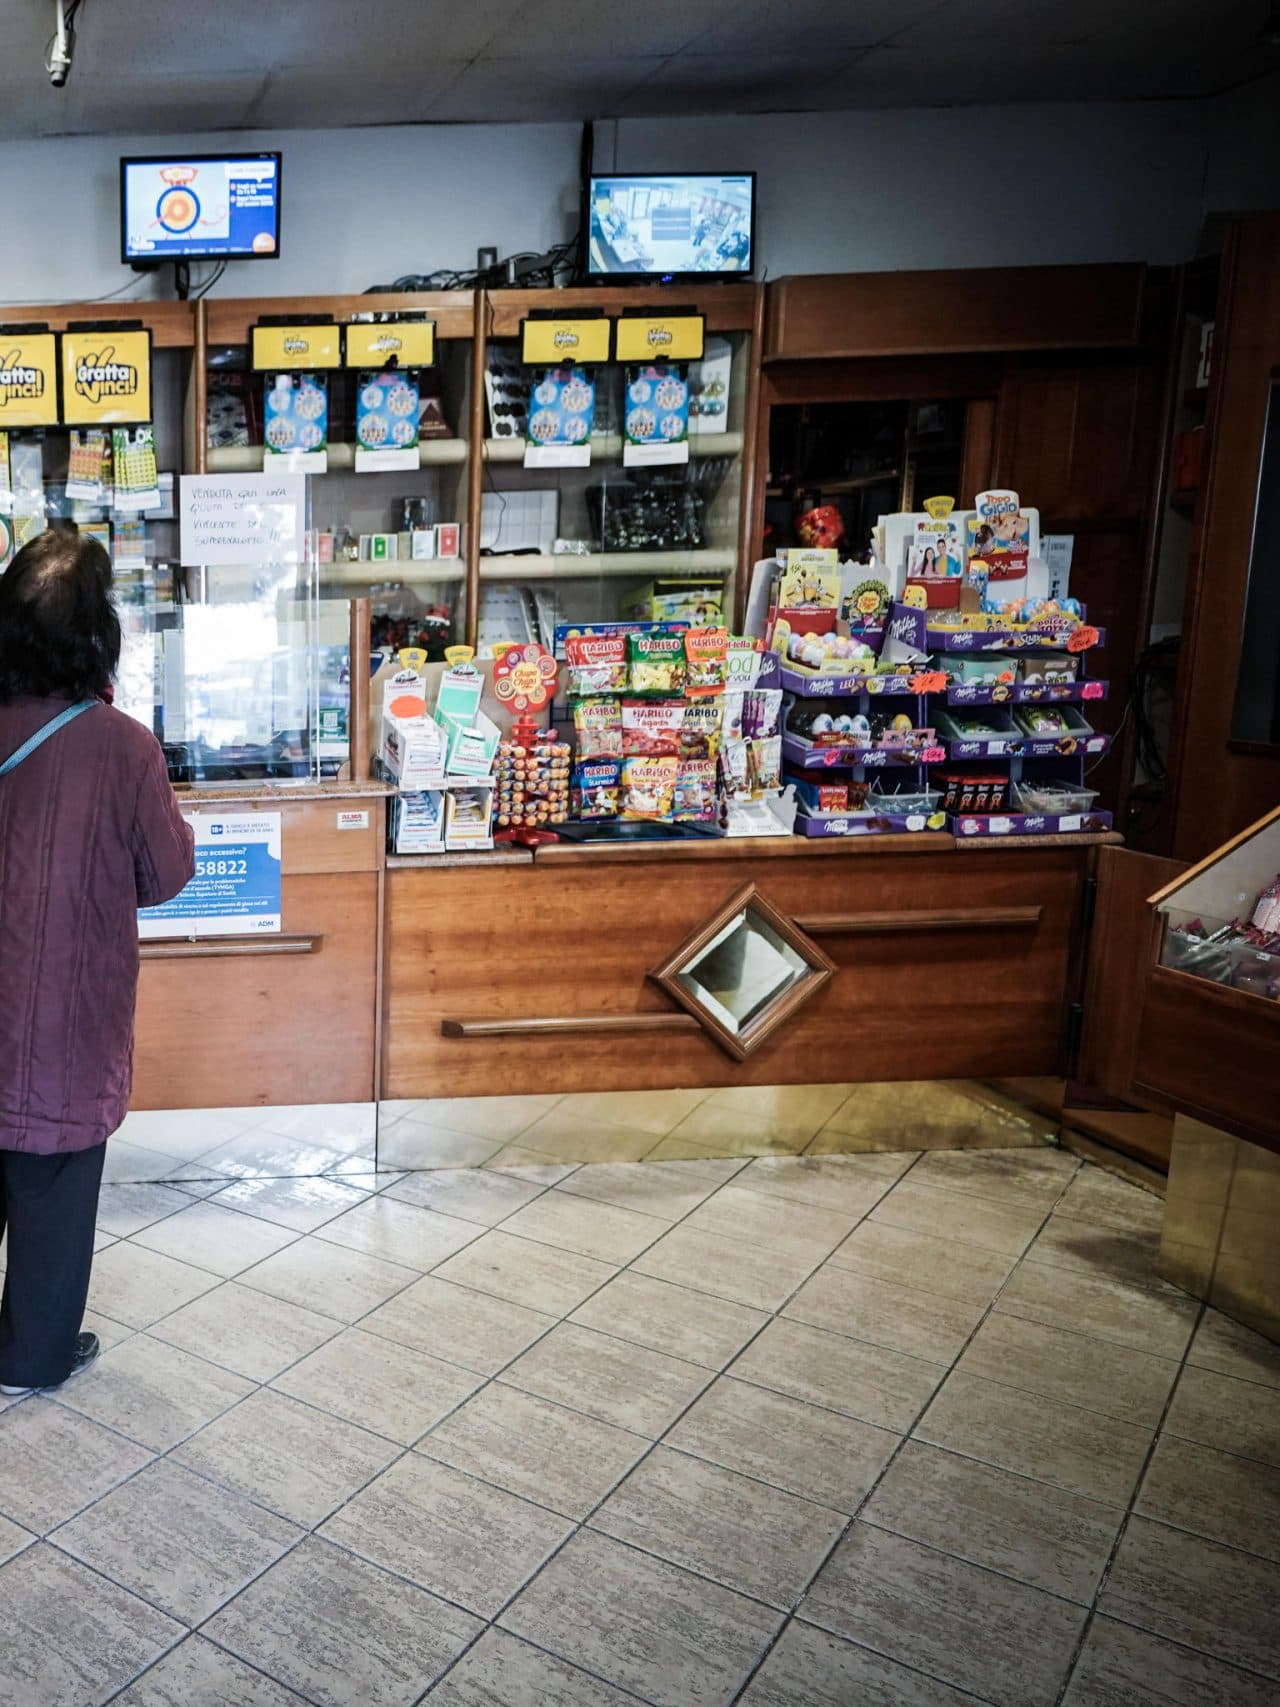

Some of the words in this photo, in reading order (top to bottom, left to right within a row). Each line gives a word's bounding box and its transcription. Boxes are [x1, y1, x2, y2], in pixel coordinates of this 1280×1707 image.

[76, 364, 129, 382] Gratta
[191, 488, 233, 499] VENDUTA
[889, 615, 918, 637] Milka
[582, 639, 624, 653] HARIBO
[639, 639, 681, 651] HARIBO
[690, 637, 724, 649] HARIBO
[726, 639, 751, 649] it-tella
[582, 706, 617, 716] HARIBO
[633, 708, 673, 719] HARIBO
[585, 766, 617, 777] HARIBO
[631, 767, 671, 778] HARIBO
[210, 847, 248, 857] eccessivo?
[195, 860, 248, 876] 58822
